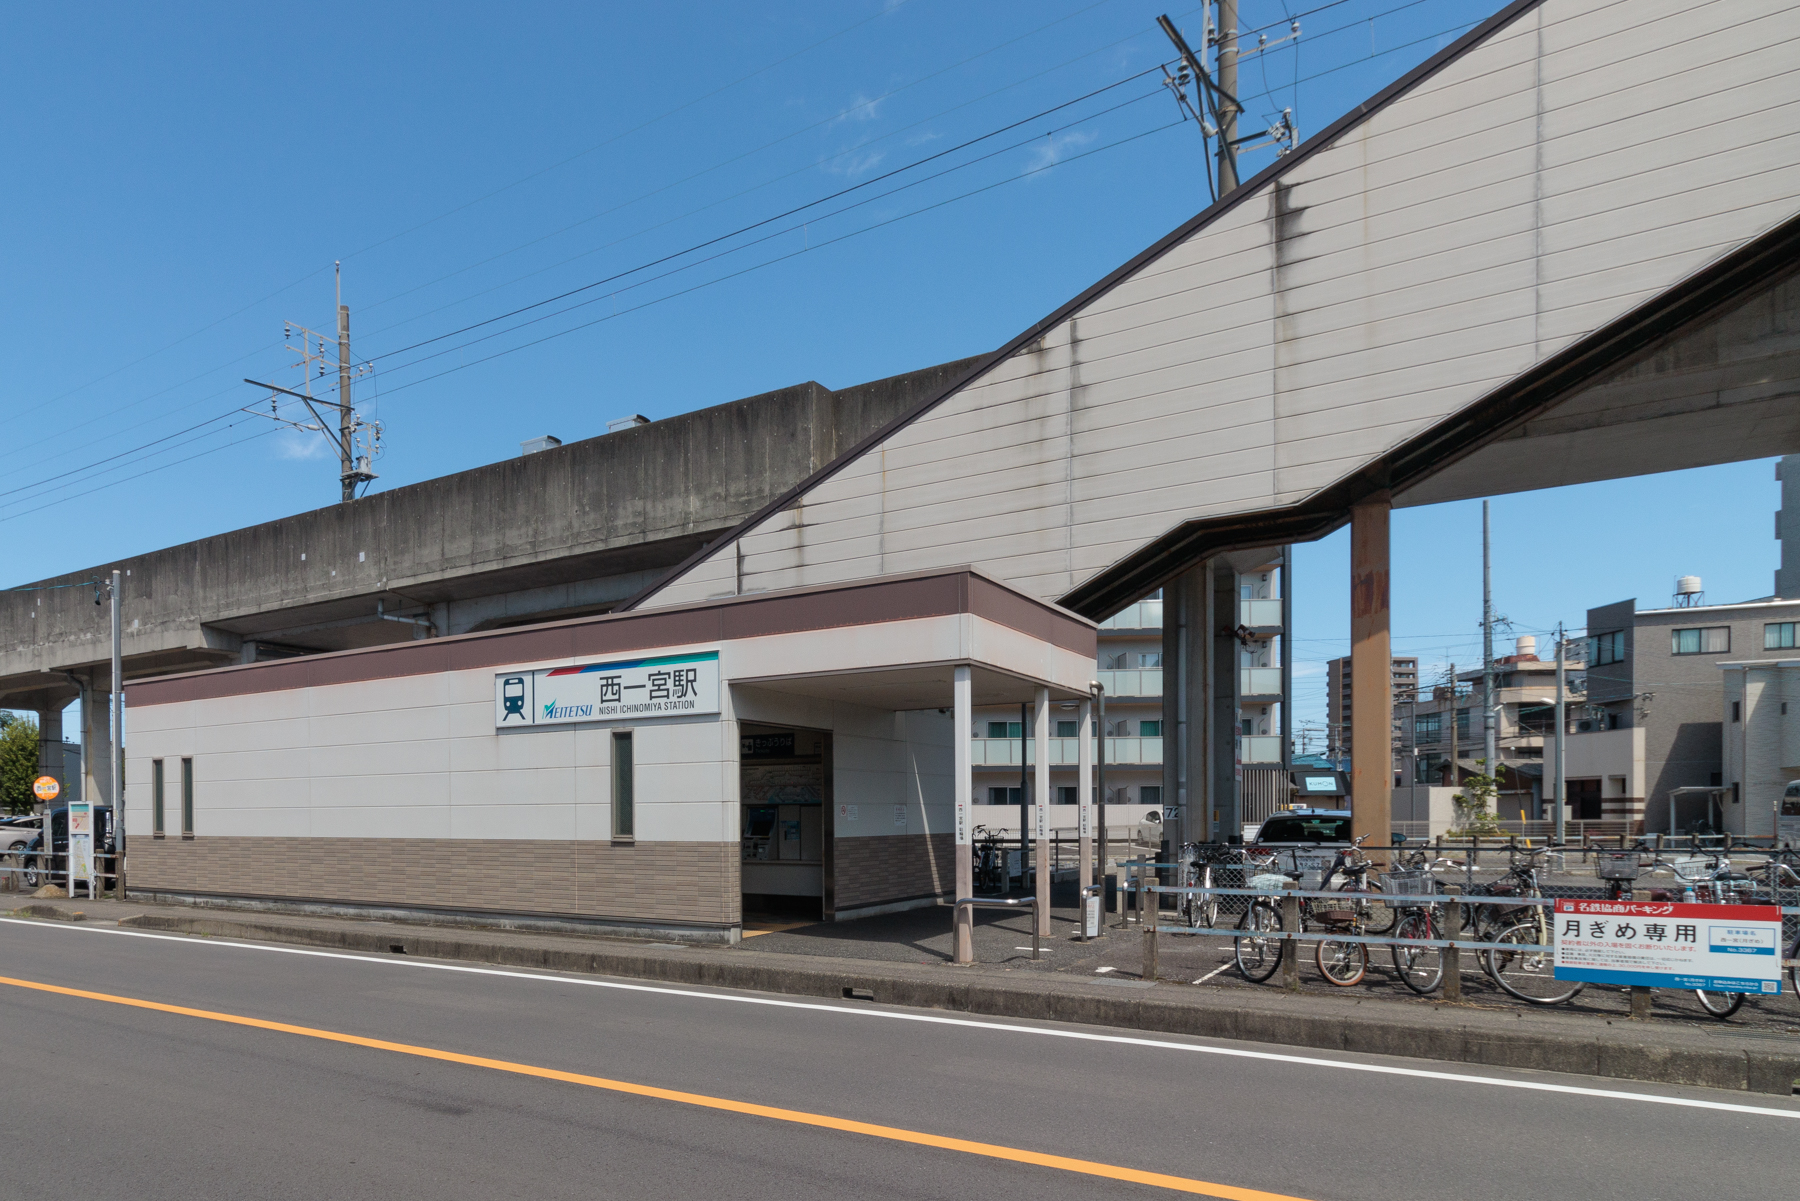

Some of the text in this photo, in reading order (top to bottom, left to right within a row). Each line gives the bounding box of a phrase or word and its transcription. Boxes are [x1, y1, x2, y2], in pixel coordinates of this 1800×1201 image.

[599, 668, 698, 704] 西一宮駅
[541, 699, 593, 720] MEITETSU
[598, 699, 695, 716] NISHI ICHINOMIYA STATION
[755, 737, 793, 748] きっぷうりば
[1578, 902, 1674, 915] 名鉄協商パーキング
[1562, 920, 1697, 943] 月ぎめ専用
